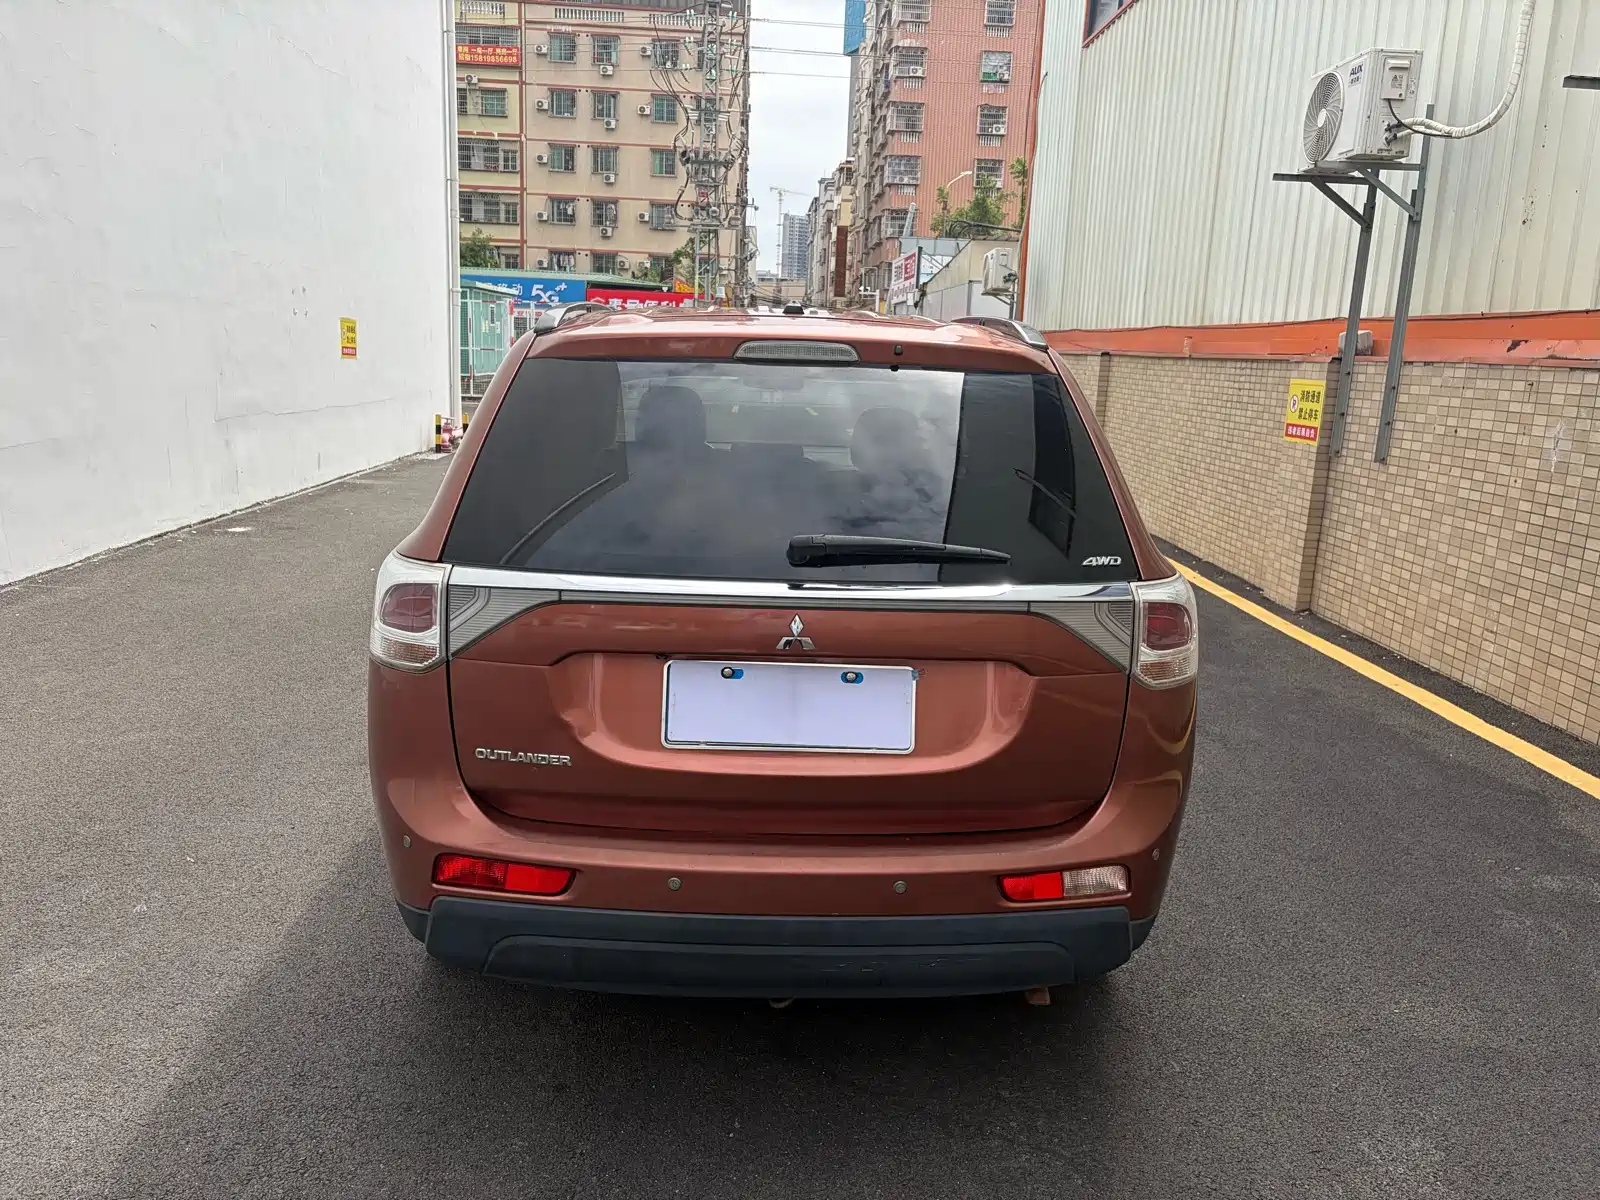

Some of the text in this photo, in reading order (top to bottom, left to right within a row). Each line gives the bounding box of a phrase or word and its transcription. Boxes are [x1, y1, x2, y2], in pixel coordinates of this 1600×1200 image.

[1349, 63, 1363, 77] AUX
[1300, 389, 1321, 403] 消防通道
[1298, 407, 1319, 422] 禁止停车
[1081, 555, 1122, 566] 4WD
[475, 747, 572, 766] OUTLANDER
